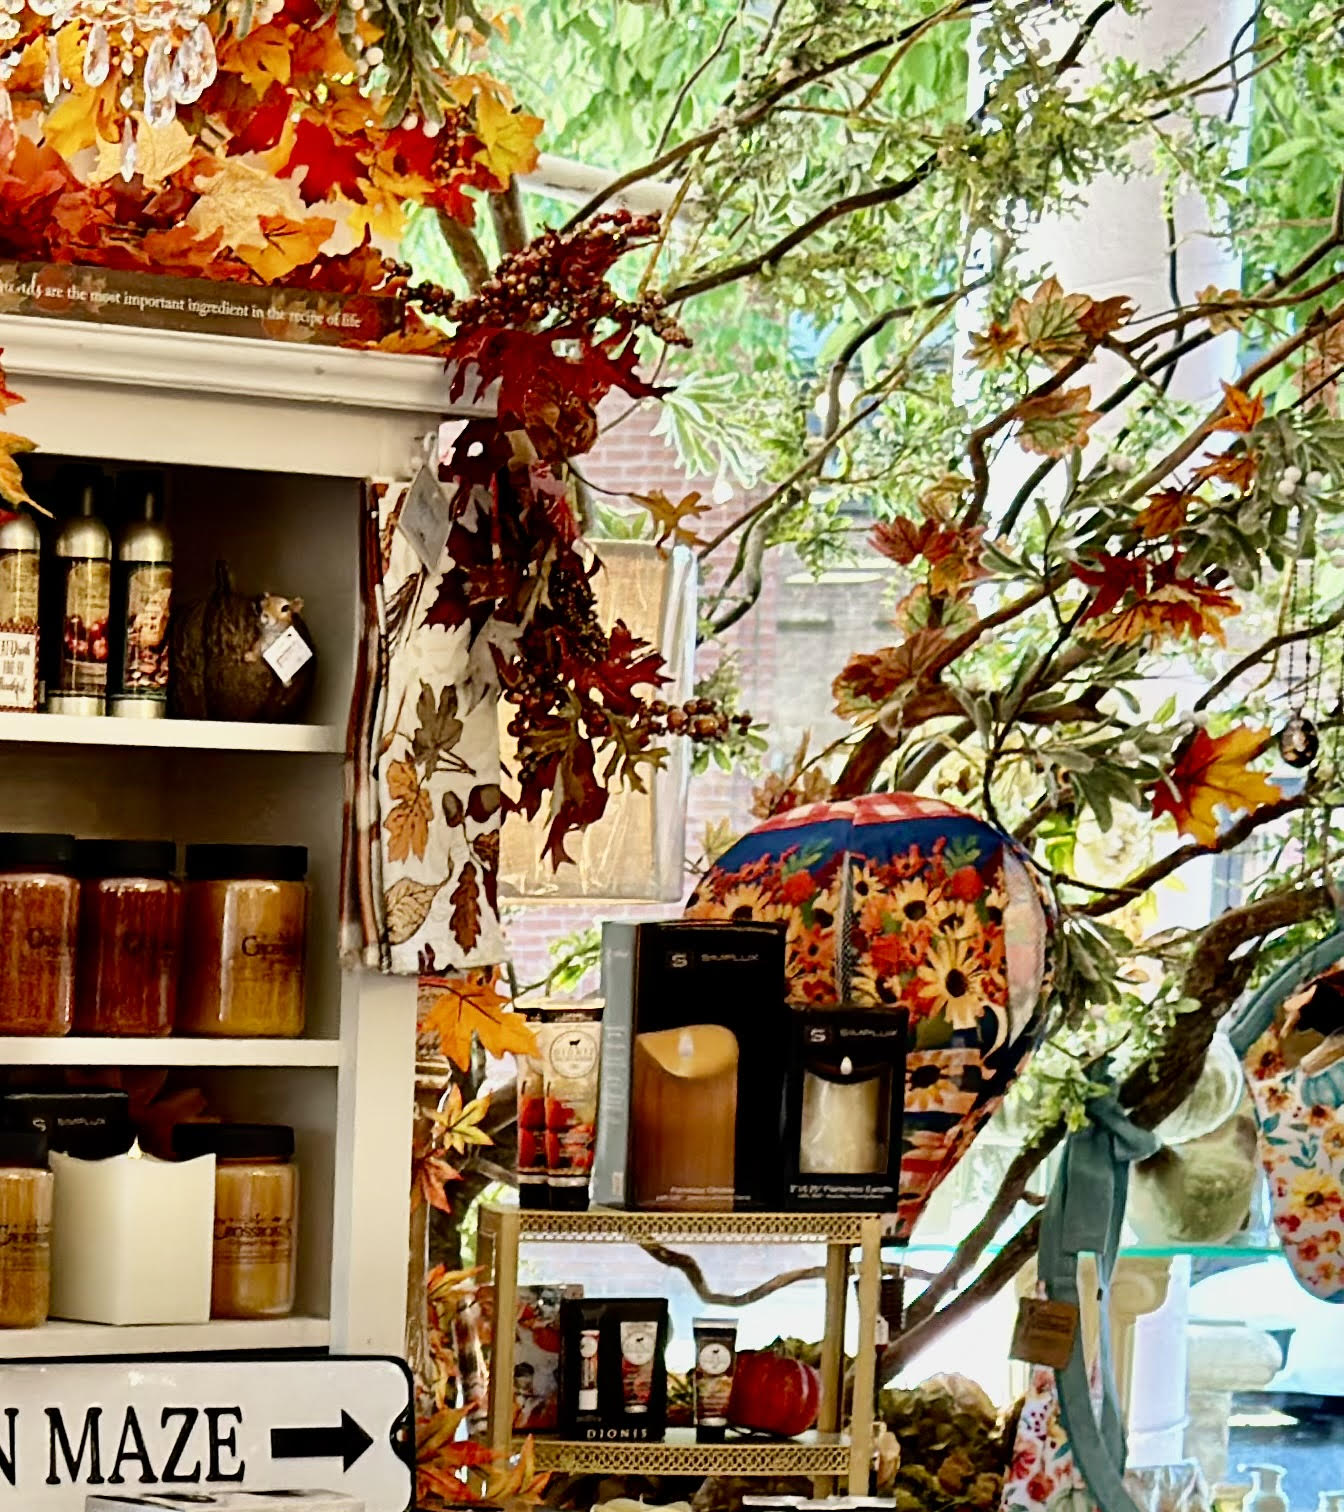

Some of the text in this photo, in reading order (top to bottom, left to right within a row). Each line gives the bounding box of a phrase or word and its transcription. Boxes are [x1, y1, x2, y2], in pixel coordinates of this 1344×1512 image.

[45, 287, 62, 298] are
[67, 285, 87, 299] the
[91, 289, 120, 304] most
[124, 292, 185, 312] important
[188, 298, 250, 319] ingredient
[252, 304, 266, 318] in
[268, 306, 287, 319] the
[290, 310, 323, 327] recipe
[326, 310, 341, 326] of
[342, 312, 362, 328] life
[44, 1404, 246, 1486] MAZE
[586, 1428, 649, 1439] DIONIS
